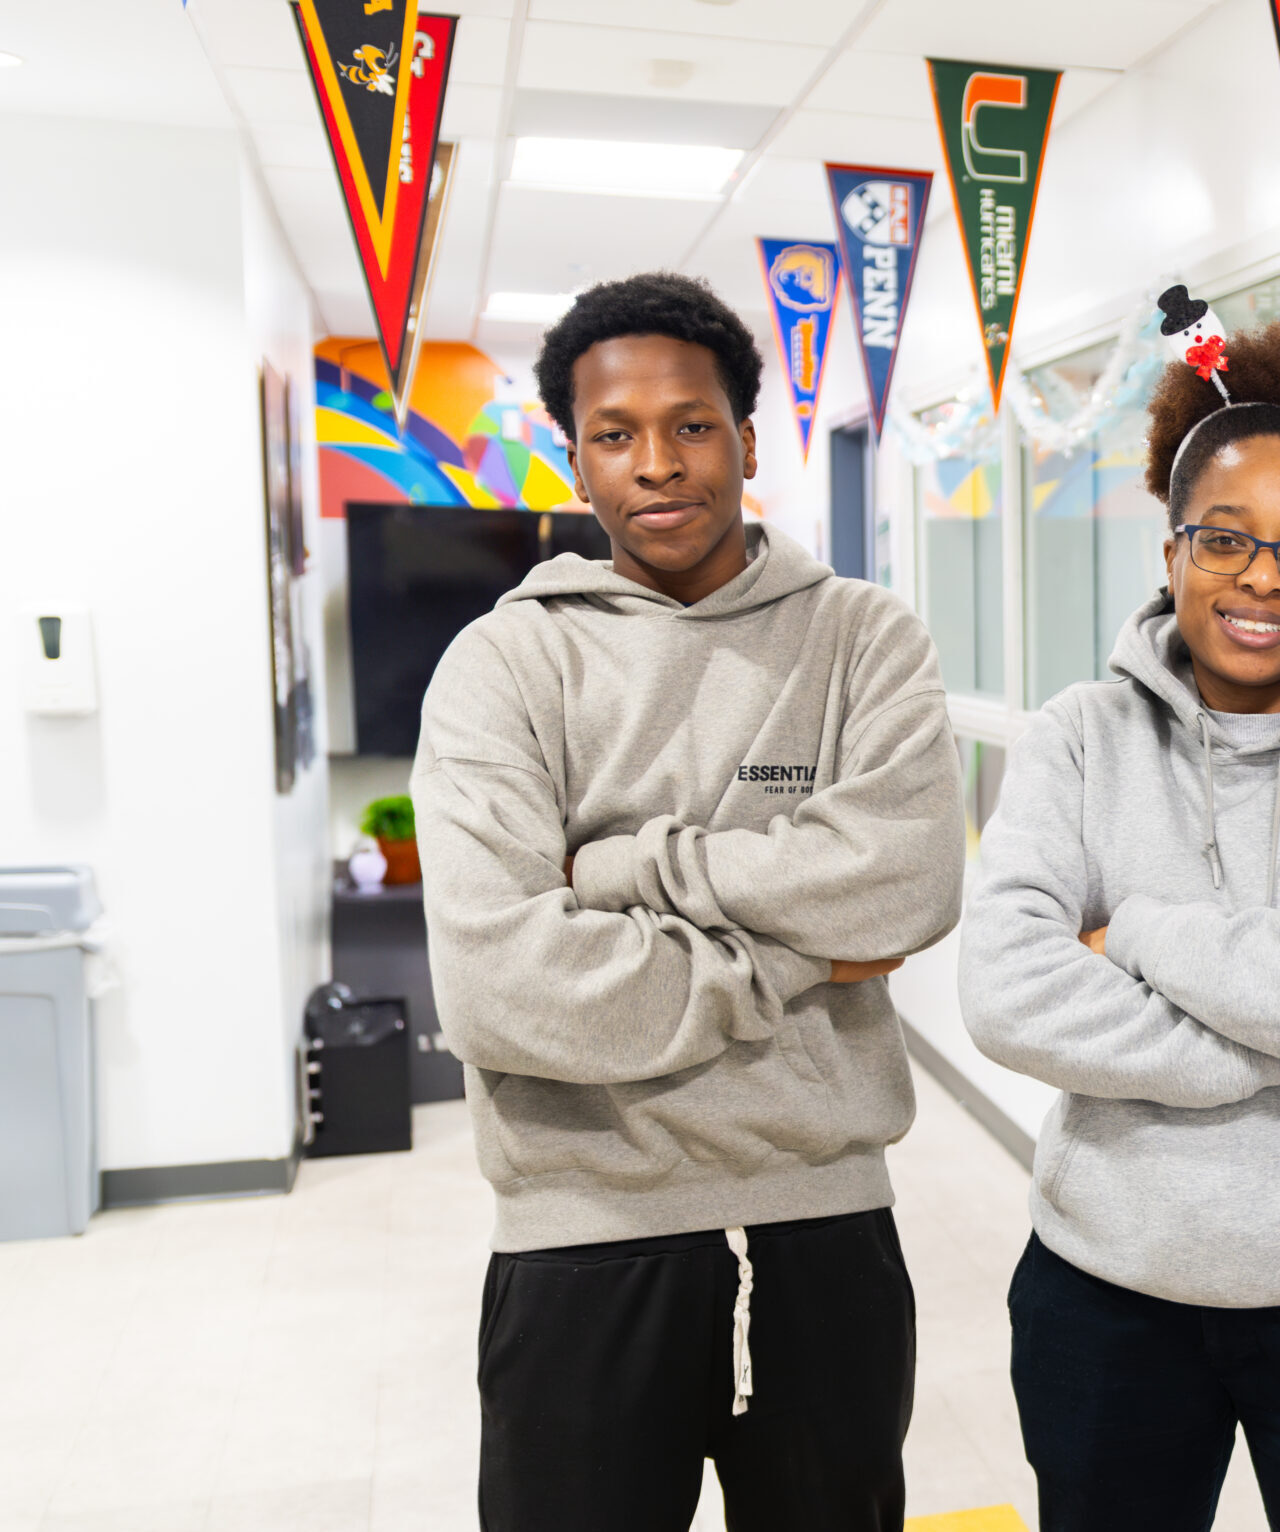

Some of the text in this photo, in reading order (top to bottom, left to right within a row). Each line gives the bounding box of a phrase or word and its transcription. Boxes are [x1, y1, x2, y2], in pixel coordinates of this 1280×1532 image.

[863, 245, 898, 350] PENN
[764, 786, 784, 794] FEAR
[788, 786, 797, 794] OF
